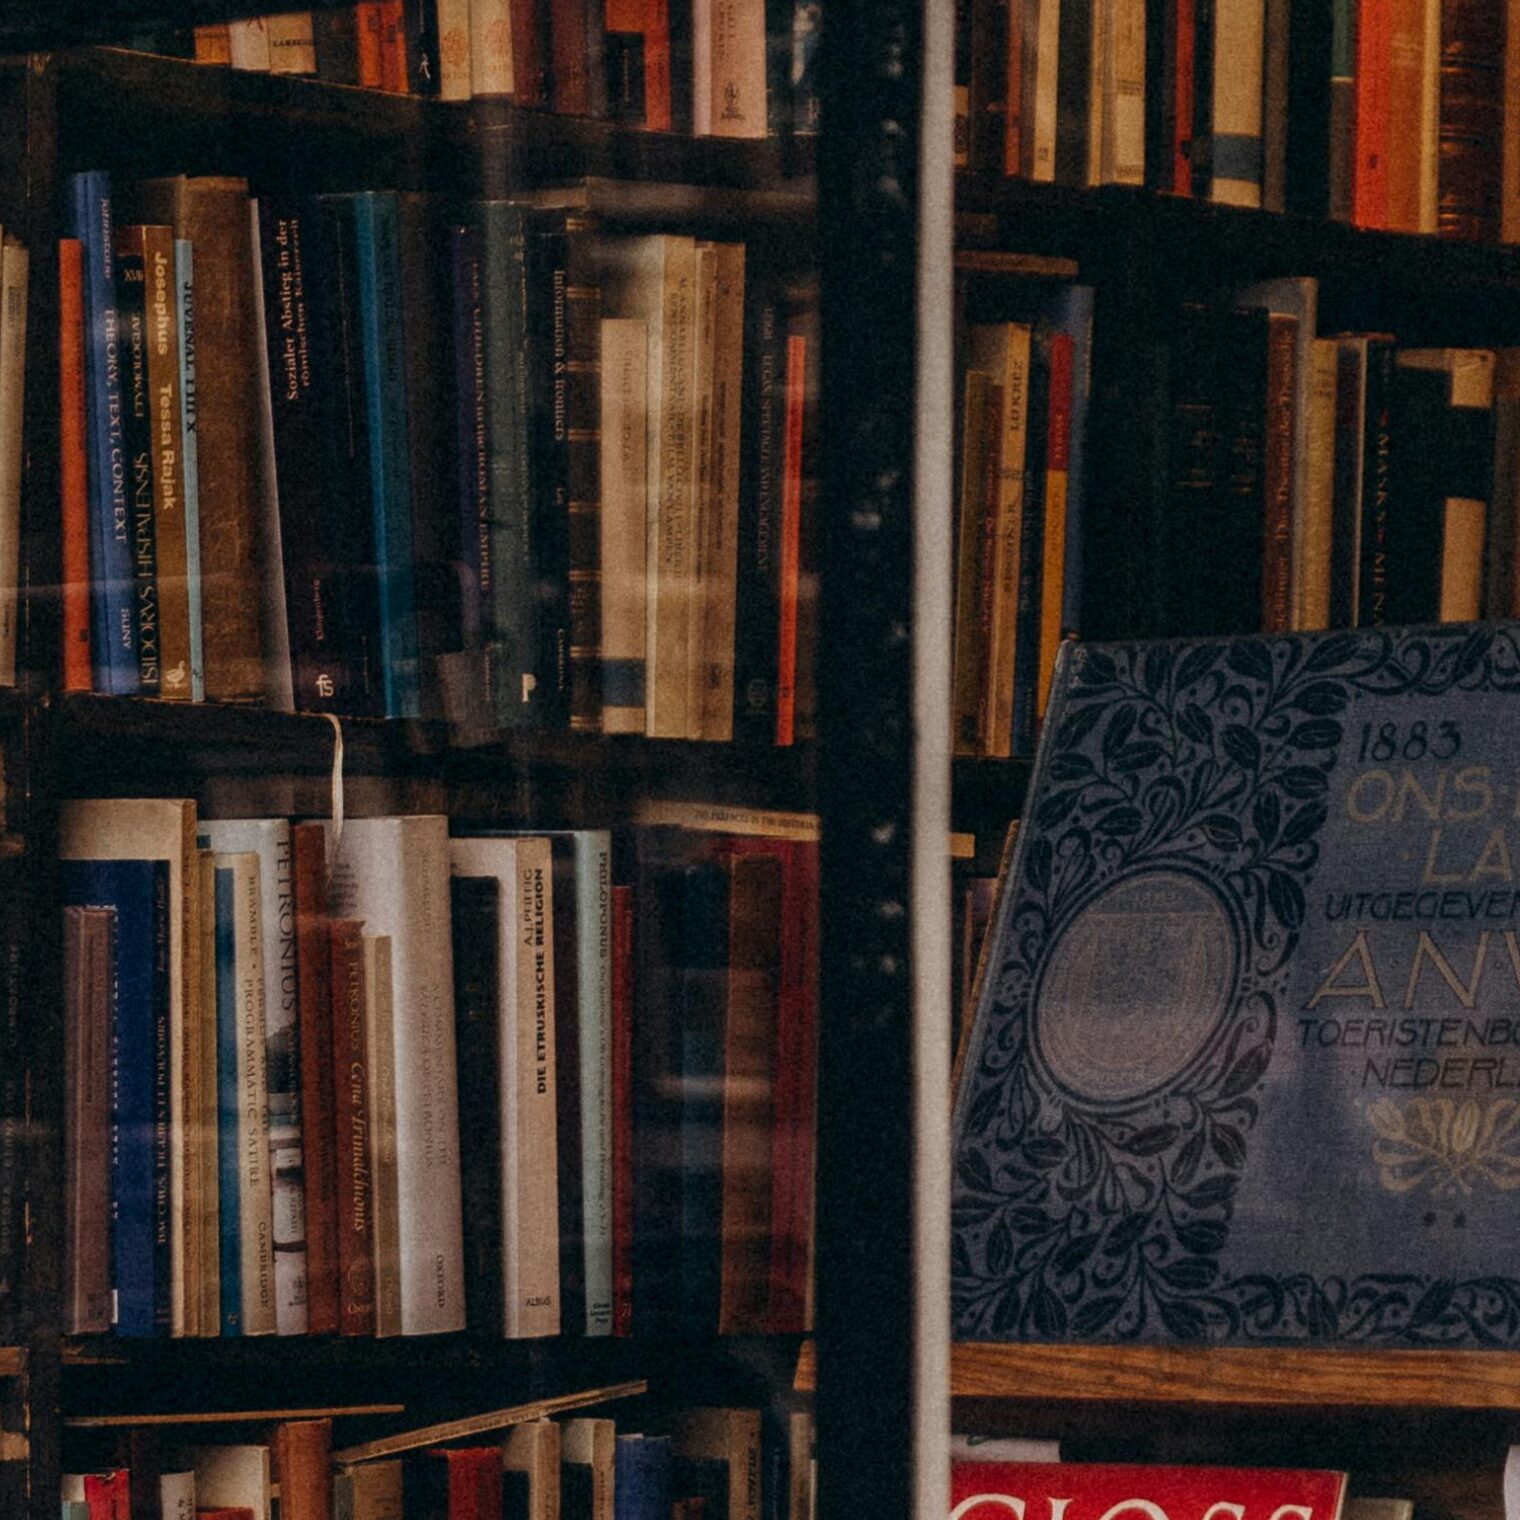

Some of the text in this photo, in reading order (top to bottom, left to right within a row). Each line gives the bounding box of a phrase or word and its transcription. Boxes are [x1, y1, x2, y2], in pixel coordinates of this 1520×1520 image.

[553, 268, 568, 365] Information
[151, 250, 177, 509] Josephus Tessa Rajak
[283, 338, 300, 402] Sozialer
[1356, 719, 1462, 765] 1883
[533, 868, 548, 1096] DIE ETRUSKISCHE RELIGION
[247, 1127, 261, 1188] SATIRE
